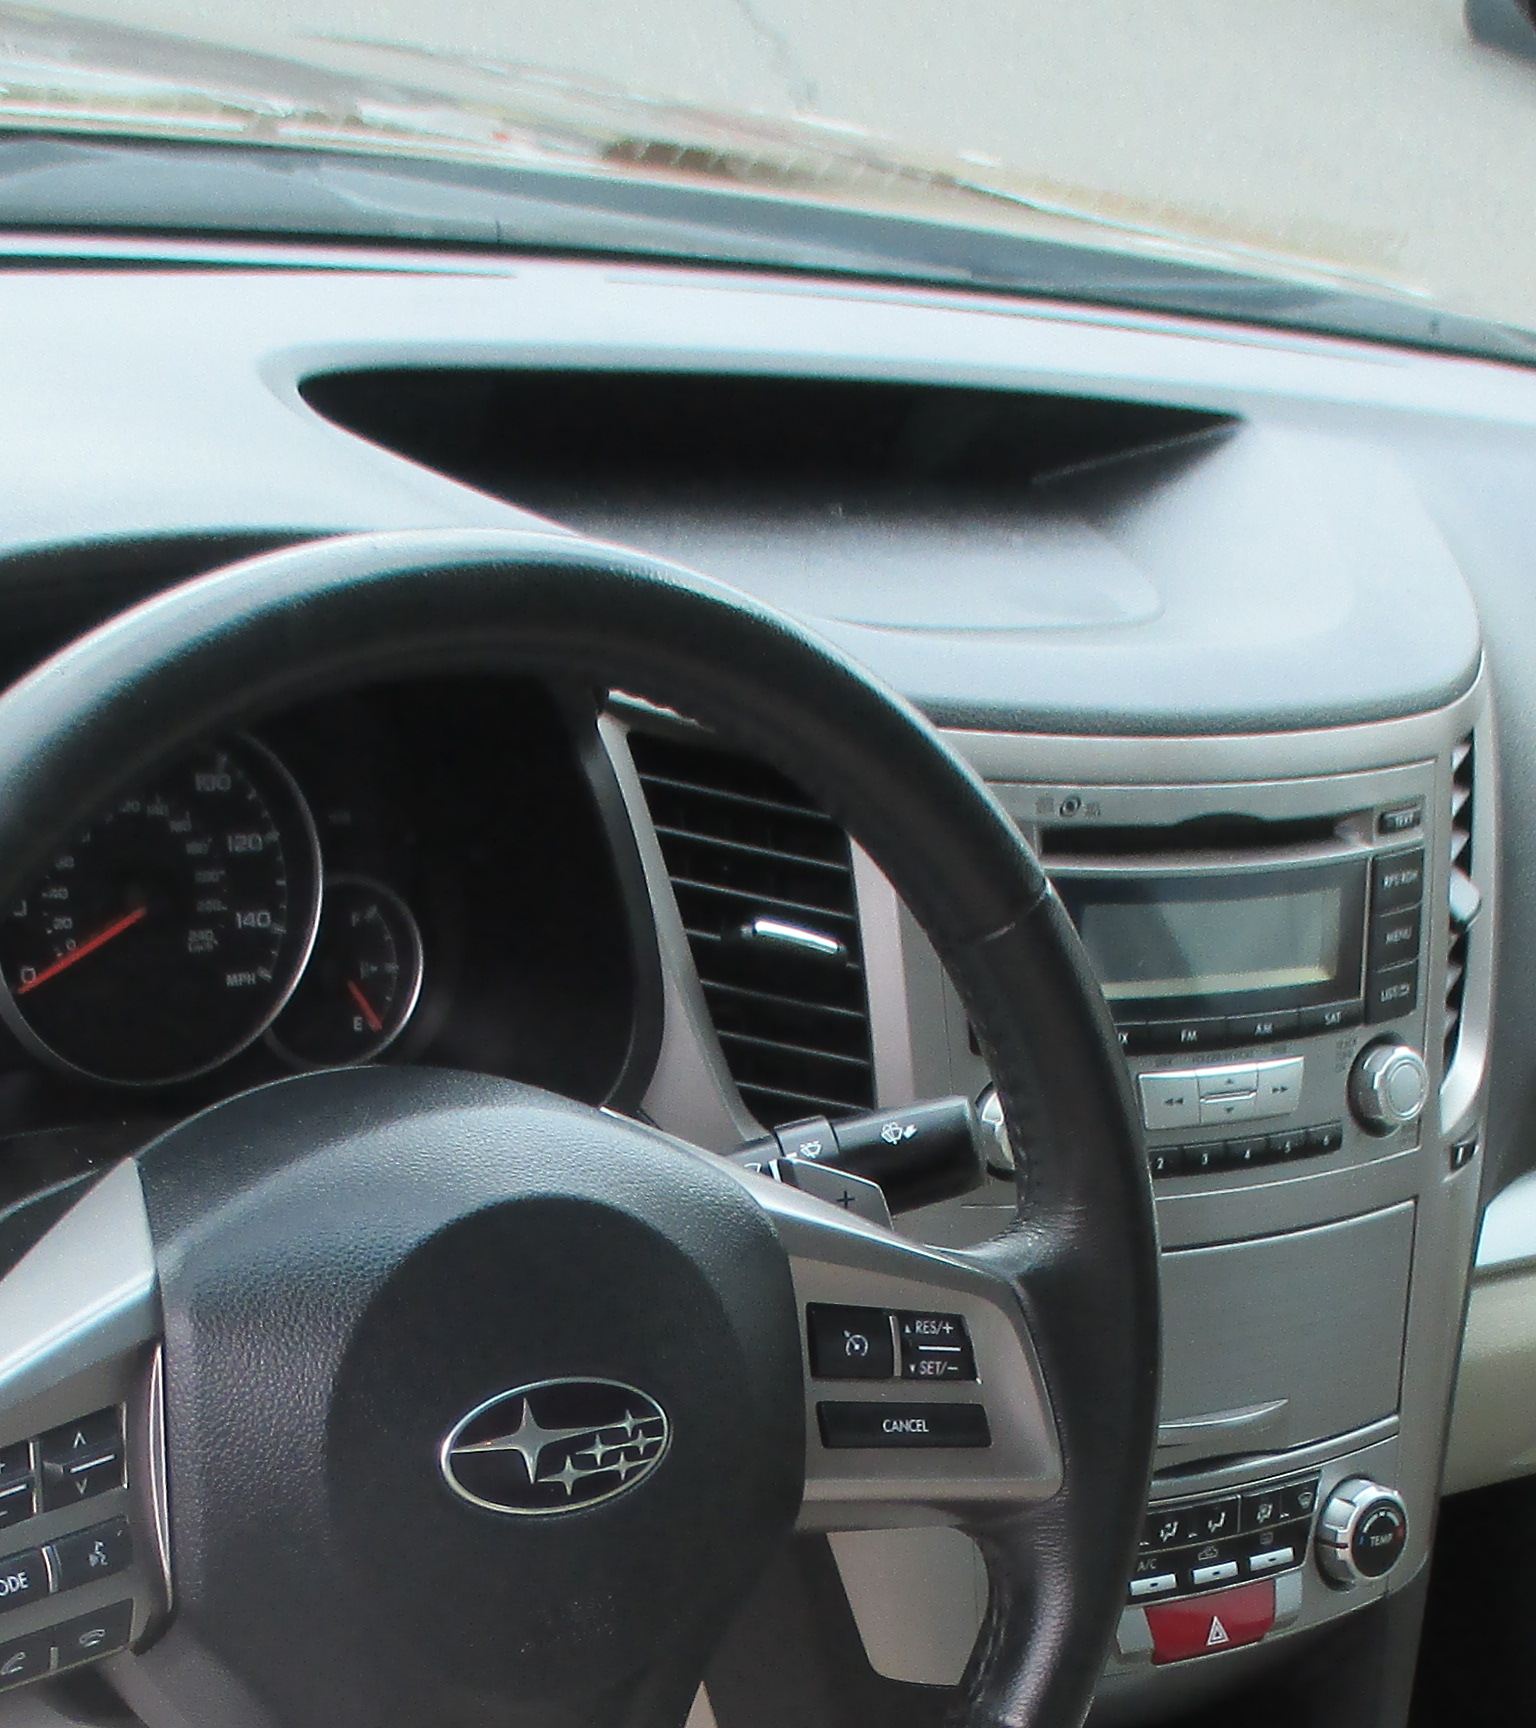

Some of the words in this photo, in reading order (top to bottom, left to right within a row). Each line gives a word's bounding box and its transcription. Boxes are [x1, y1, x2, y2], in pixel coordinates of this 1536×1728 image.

[235, 911, 272, 930] 140
[225, 972, 257, 988] MPH
[1324, 1011, 1343, 1026] SAT
[1180, 1029, 1199, 1042] FM
[1156, 1157, 1164, 1170] 2
[1243, 1149, 1252, 1160] 4
[882, 1418, 930, 1433] CANCEL
[1369, 1532, 1394, 1548] TEMP
[1137, 1557, 1157, 1572] A/C
